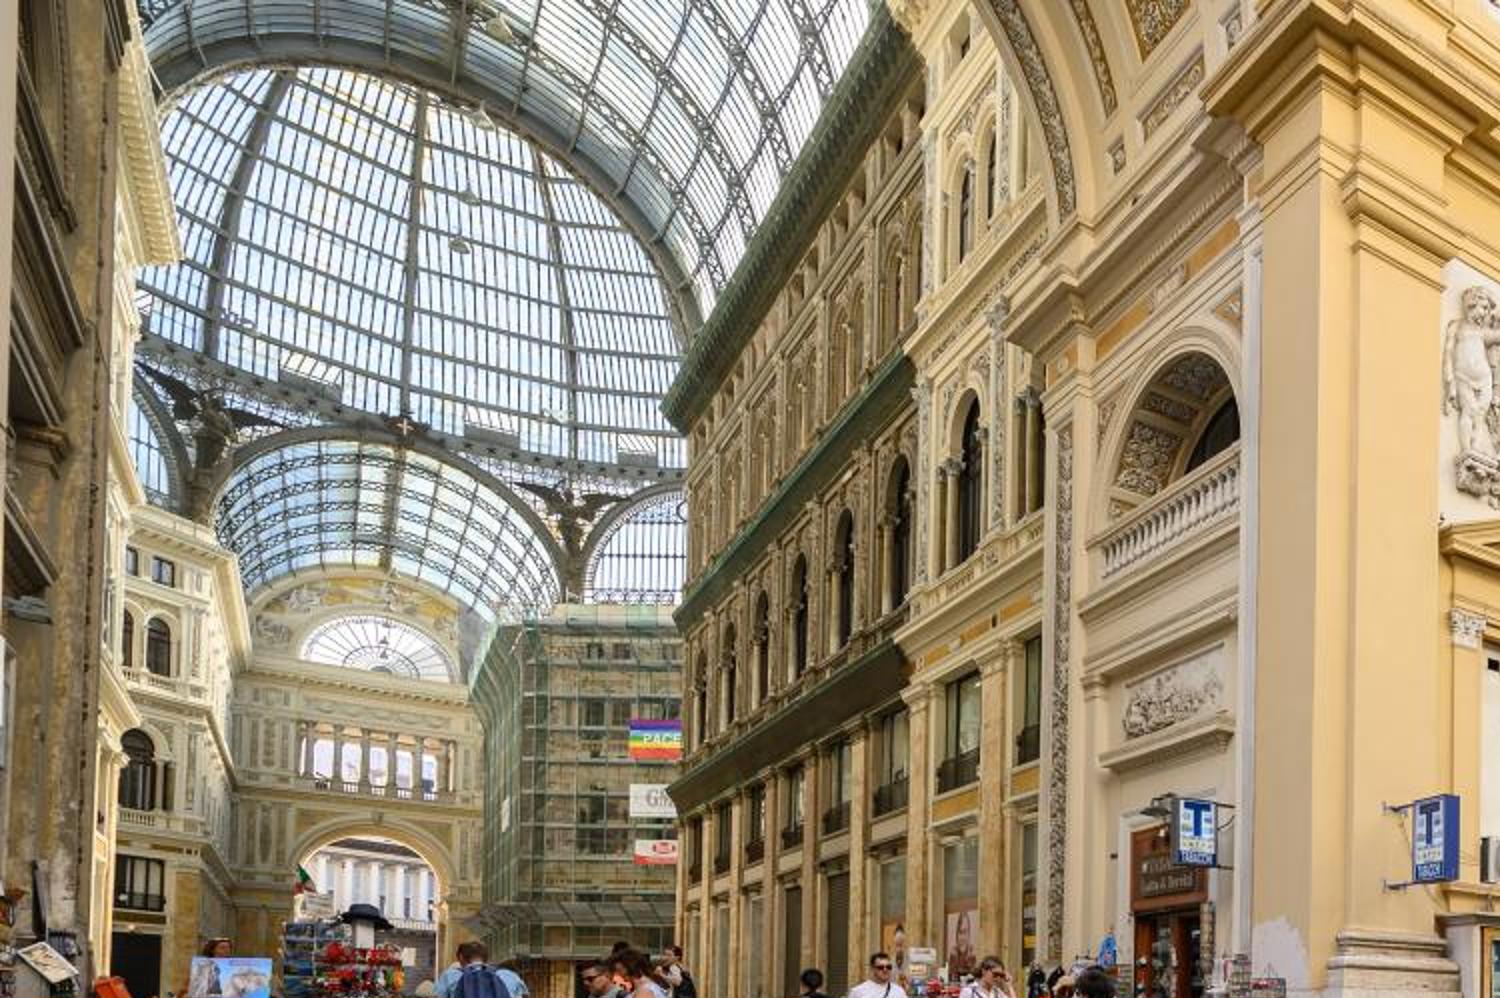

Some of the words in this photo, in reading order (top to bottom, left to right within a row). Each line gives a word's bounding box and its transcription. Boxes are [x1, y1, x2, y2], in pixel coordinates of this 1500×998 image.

[643, 733, 682, 745] PACE
[1184, 801, 1211, 837] T
[1419, 801, 1440, 844] T
